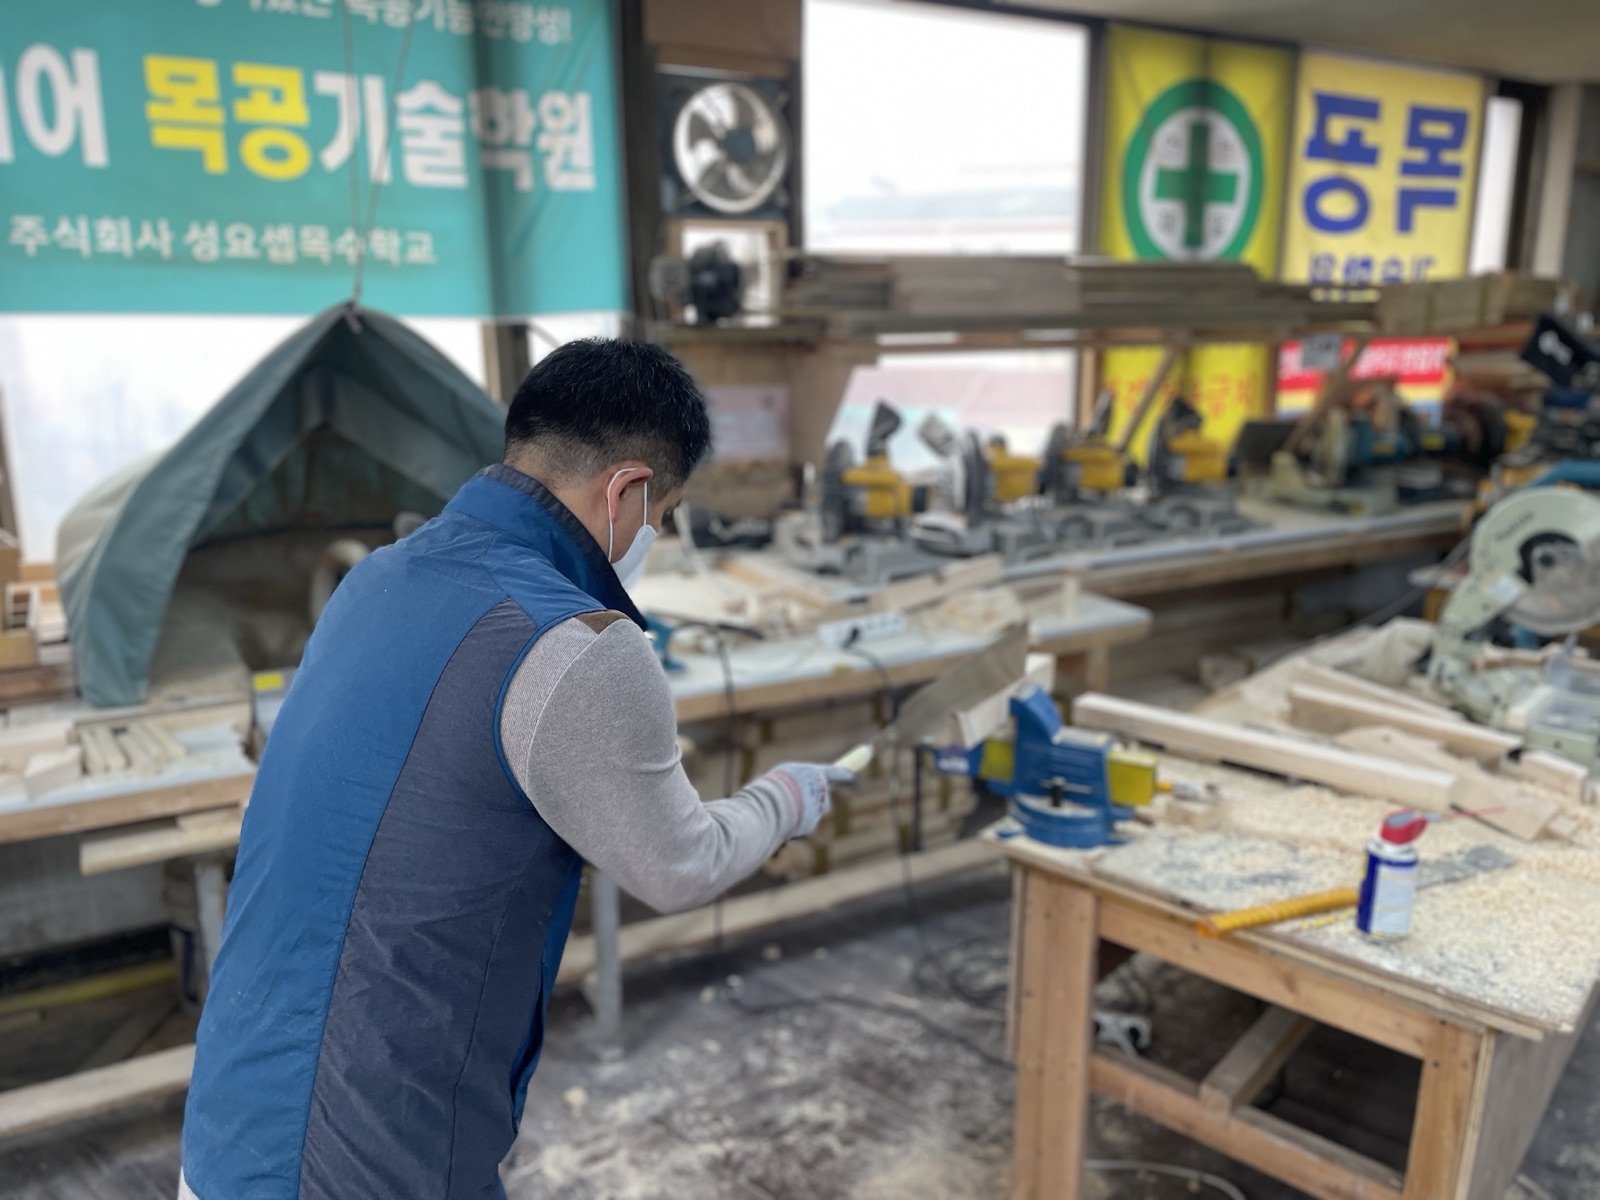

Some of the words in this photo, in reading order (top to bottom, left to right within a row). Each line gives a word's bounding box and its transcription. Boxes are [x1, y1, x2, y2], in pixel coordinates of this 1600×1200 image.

[0, 44, 109, 167] 어
[9, 214, 174, 259] 주식회사
[183, 219, 437, 266] 성요셉목수학교
